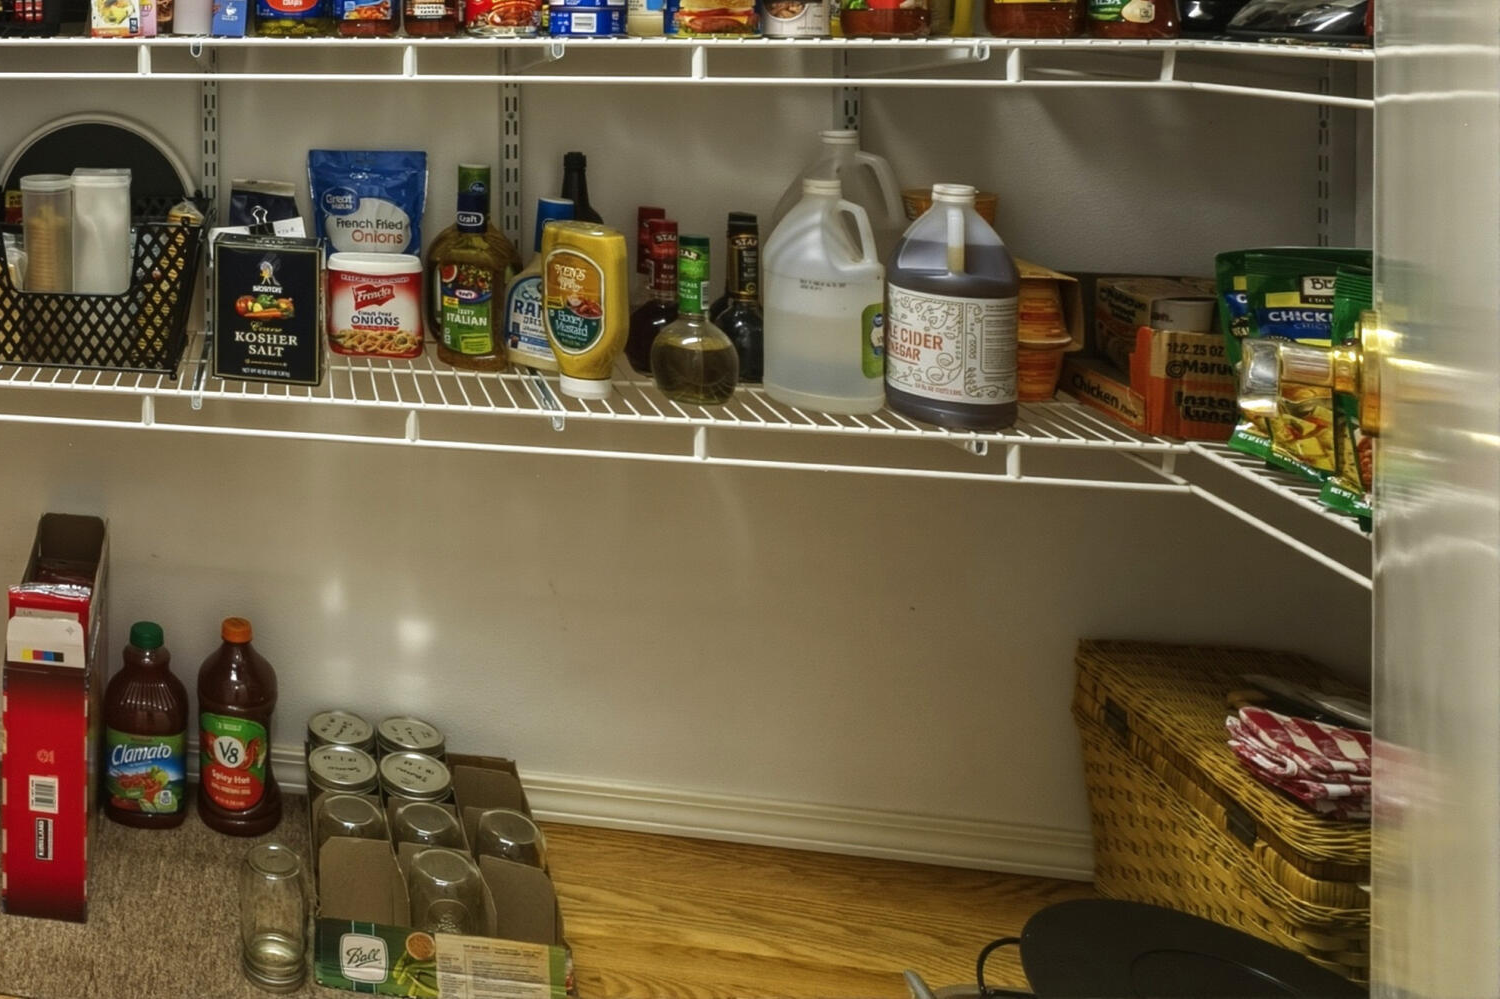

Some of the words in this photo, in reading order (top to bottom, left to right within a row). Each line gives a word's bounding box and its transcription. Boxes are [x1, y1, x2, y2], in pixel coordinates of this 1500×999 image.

[336, 217, 374, 230] French
[376, 217, 403, 230] Fried
[351, 229, 404, 245] Onions
[513, 300, 543, 314] RAN
[350, 315, 400, 326] ONIONS
[446, 312, 488, 327] ITALIAN
[1267, 310, 1333, 323] CHICK
[554, 319, 589, 338] Mustard
[234, 331, 298, 347] KOSHER
[900, 327, 943, 351] CIDER
[248, 344, 285, 358] SALT
[1070, 372, 1121, 411] Chicken
[111, 743, 173, 765] Clamato
[218, 741, 240, 764] V8
[346, 947, 382, 967] Ball
